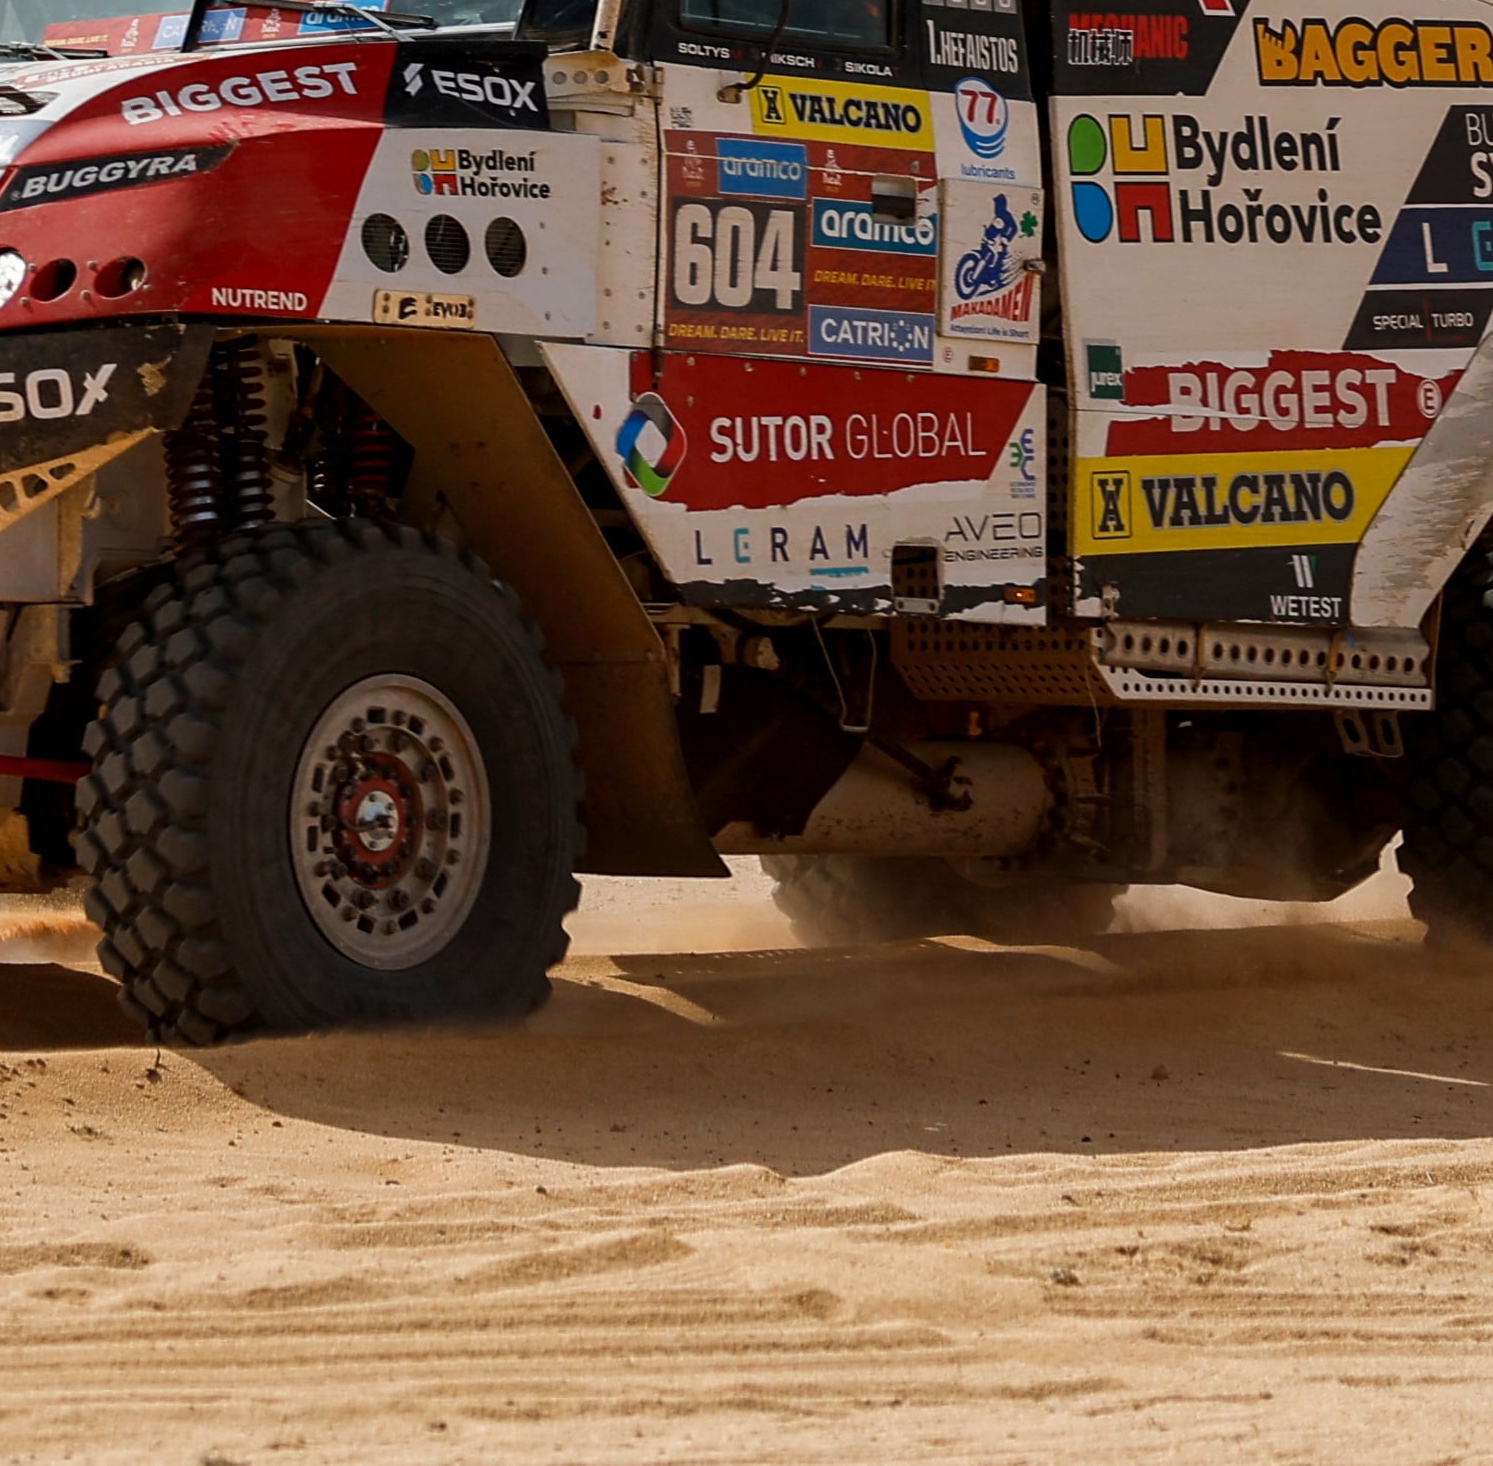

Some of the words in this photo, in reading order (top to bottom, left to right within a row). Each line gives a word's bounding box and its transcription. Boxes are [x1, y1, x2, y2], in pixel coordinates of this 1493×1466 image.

[678, 42, 730, 59] SOLTYS
[845, 61, 893, 77] SIKOLA
[121, 61, 360, 126] BIGGEST
[432, 69, 539, 114] ESOX
[960, 89, 999, 124] 77
[789, 92, 923, 134] VALCANO
[458, 147, 536, 175] Bydlení
[1172, 114, 1343, 188] Bydlení
[20, 153, 199, 201] BUGGYRA
[723, 157, 802, 181] aramco
[962, 163, 1016, 180] lubricants
[460, 173, 551, 200] Hořovice
[1179, 188, 1383, 245] Hořovice
[673, 203, 802, 311] 604
[211, 286, 308, 312] NUTREND
[669, 322, 718, 339] DREAM.
[720, 324, 758, 341] DARE.
[760, 328, 787, 342] LIVE
[1373, 313, 1423, 332] SPECIAL
[1431, 312, 1474, 330] TURBO
[1168, 368, 1397, 433] BIGGEST
[710, 414, 835, 463] SUTOR
[846, 411, 987, 460] GLOBAL
[1142, 469, 1355, 529] VALCANO
[944, 512, 1042, 542] AVEO
[944, 546, 1044, 563] ENGINEERING
[1270, 594, 1343, 619] WETEST
